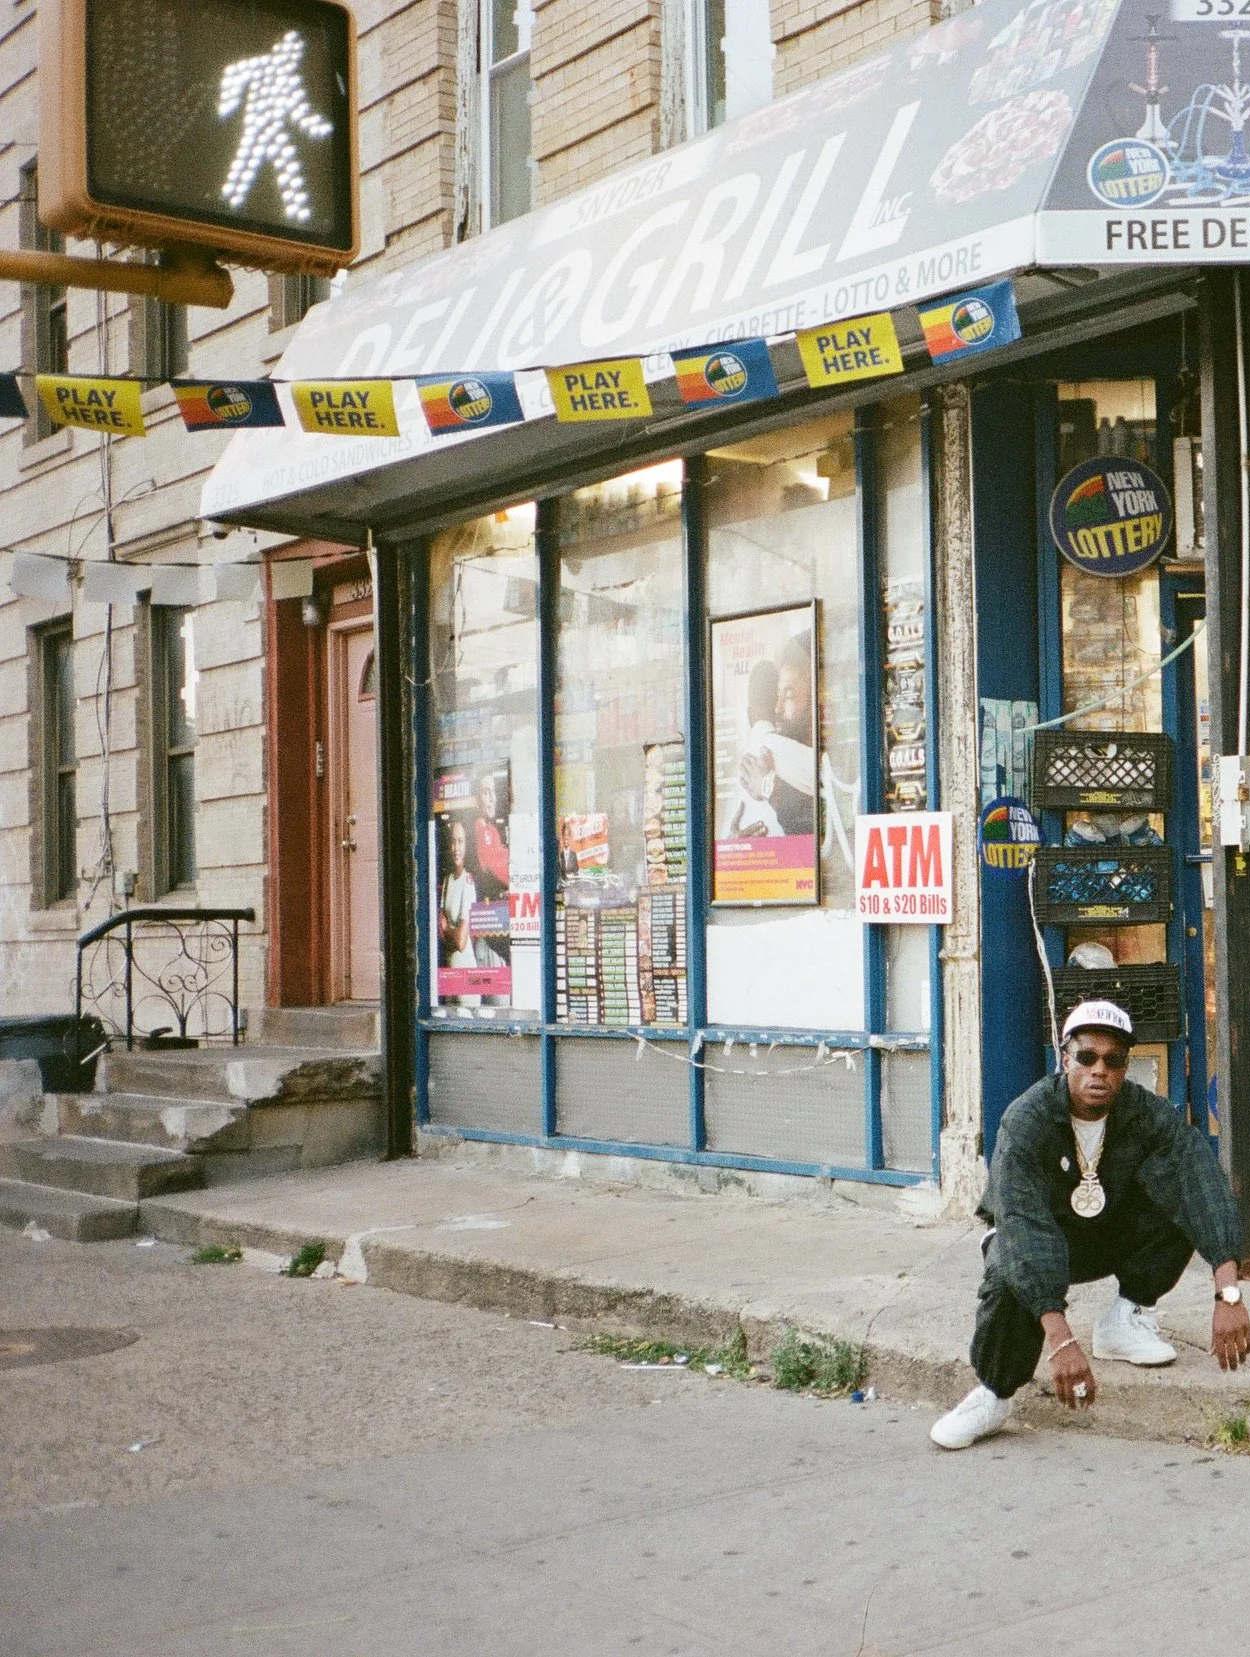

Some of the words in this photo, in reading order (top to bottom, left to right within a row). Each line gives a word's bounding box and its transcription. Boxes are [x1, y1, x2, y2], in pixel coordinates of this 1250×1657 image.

[569, 160, 673, 229] SNYDER
[580, 99, 921, 348] GRILL
[1106, 219, 1190, 250] FREE
[823, 273, 889, 317] LOTTO
[895, 270, 910, 294] &
[916, 242, 983, 289] MORE
[816, 327, 873, 354] PLAY
[823, 348, 890, 375] HERE.
[564, 370, 622, 392] PLAY
[56, 387, 117, 406] PLAY
[310, 391, 370, 409] PLAY
[570, 391, 639, 412] HERE.
[63, 404, 133, 429] HERE.
[314, 411, 385, 429] HERE.
[1106, 470, 1145, 490] NEW
[1112, 489, 1158, 518] YORK
[1067, 512, 1163, 560] LOTTERY
[861, 824, 945, 890] ATM
[508, 892, 541, 918] TM
[860, 894, 880, 916] $10
[883, 897, 891, 915] &
[894, 893, 917, 915] $20
[920, 892, 947, 915] Bills
